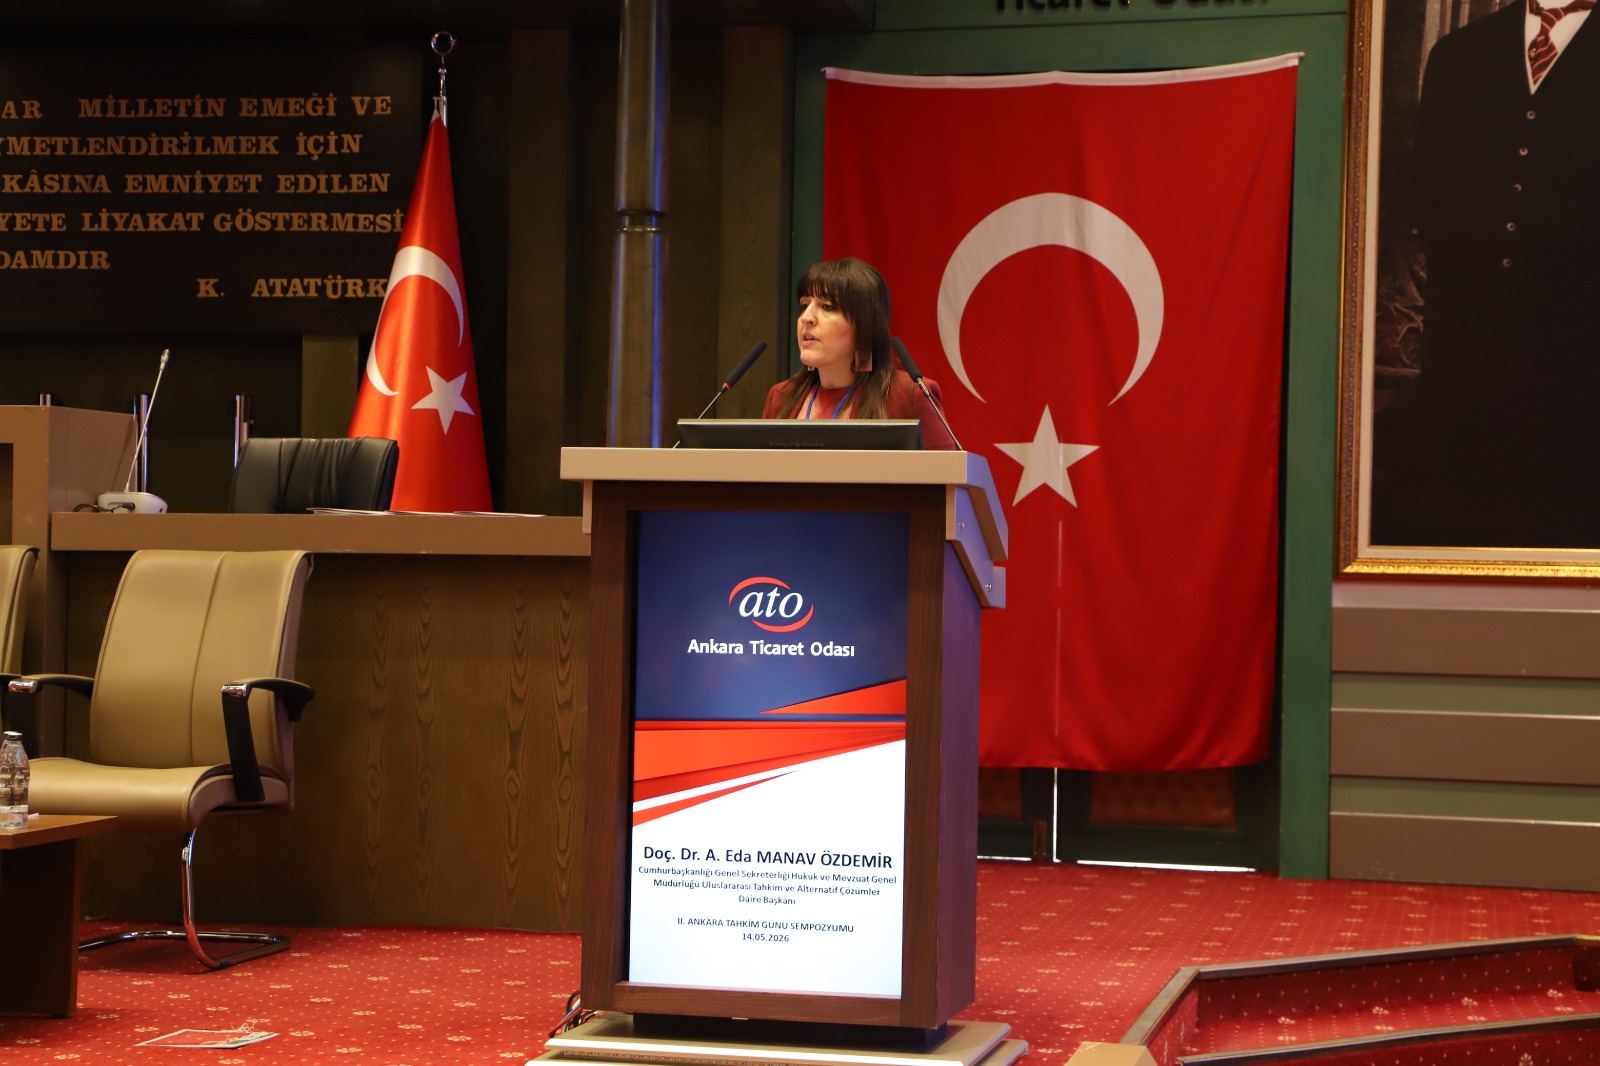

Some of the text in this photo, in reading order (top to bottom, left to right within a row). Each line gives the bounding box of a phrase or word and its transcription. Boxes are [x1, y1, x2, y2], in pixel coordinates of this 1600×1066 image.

[1, 92, 392, 119] AR MİLLETİN EMEĞİ VE
[0, 131, 363, 161] METLENDİRİLMEK İÇİN
[1, 169, 391, 194] KÂSINA EMNİYET EDİLEN
[81, 208, 204, 232] LİYAKAT
[213, 208, 404, 233] GÖSTERMESİ
[196, 275, 388, 299] K. ATATÜRK
[739, 586, 804, 618] ato
[687, 638, 855, 657] Ankara Ticaret Odası
[643, 846, 893, 869] Doç. Dr. A. Eda MANAV ÖZDEMİR
[638, 866, 713, 877] Cumhurbaşkanlığı
[714, 869, 740, 878] Genel
[741, 870, 790, 881] Sekreterliği
[791, 872, 818, 881] Hukuk
[832, 874, 870, 883] Mevzuat
[871, 875, 897, 884] Genel
[653, 879, 700, 890] Müdürlüğü
[701, 881, 751, 890] Uluslararası
[753, 883, 783, 891] Tahkim
[797, 885, 838, 894] Alternatif
[839, 887, 881, 896] Çözümler
[738, 895, 796, 906] Daire Başkanı
[687, 918, 724, 927] ANKARA
[725, 919, 760, 929] TAHKİM
[761, 920, 788, 930] GÜNÜ
[790, 923, 855, 933] SEMPOZYUMU
[742, 933, 790, 943] 14.05.2026
